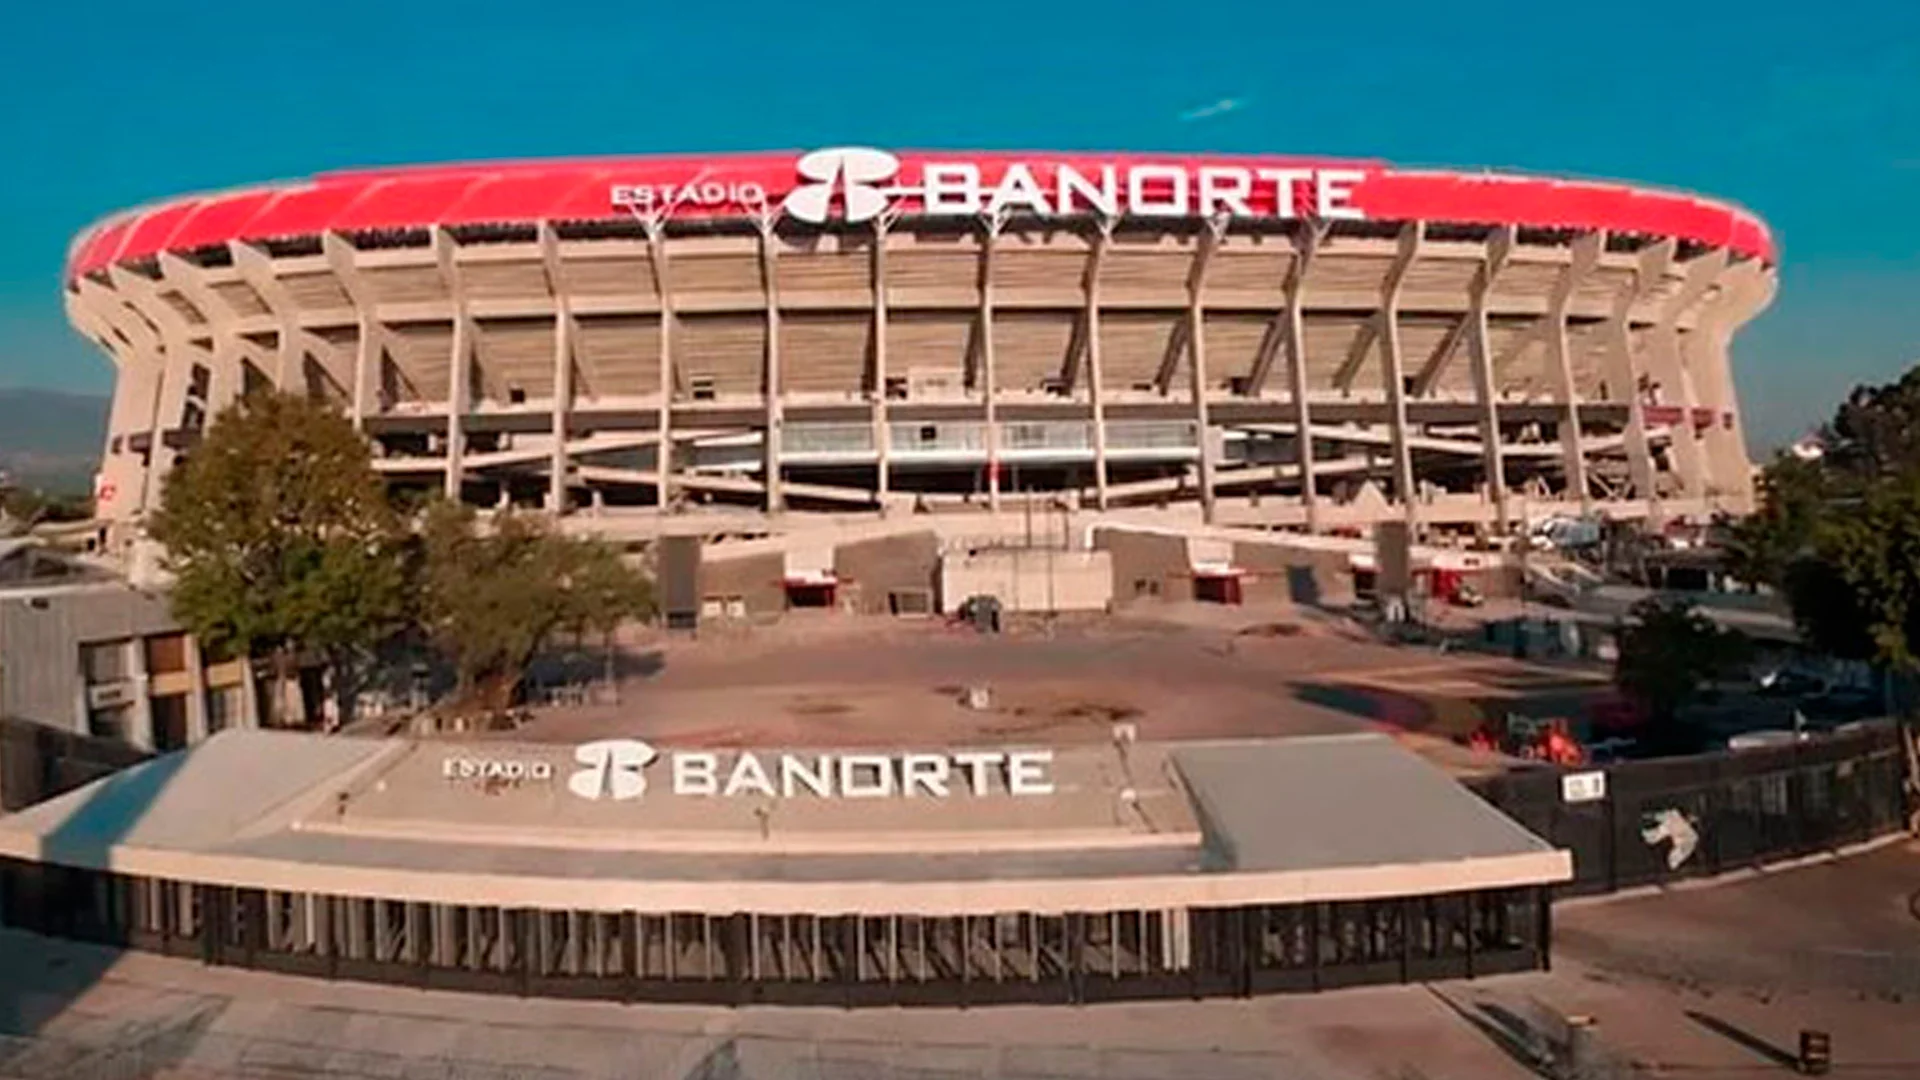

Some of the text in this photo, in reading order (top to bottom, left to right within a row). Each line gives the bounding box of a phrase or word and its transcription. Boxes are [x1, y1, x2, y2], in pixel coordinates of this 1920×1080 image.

[611, 163, 1365, 219] ESTADIO BANORTE
[673, 751, 1053, 797] BANORTE
